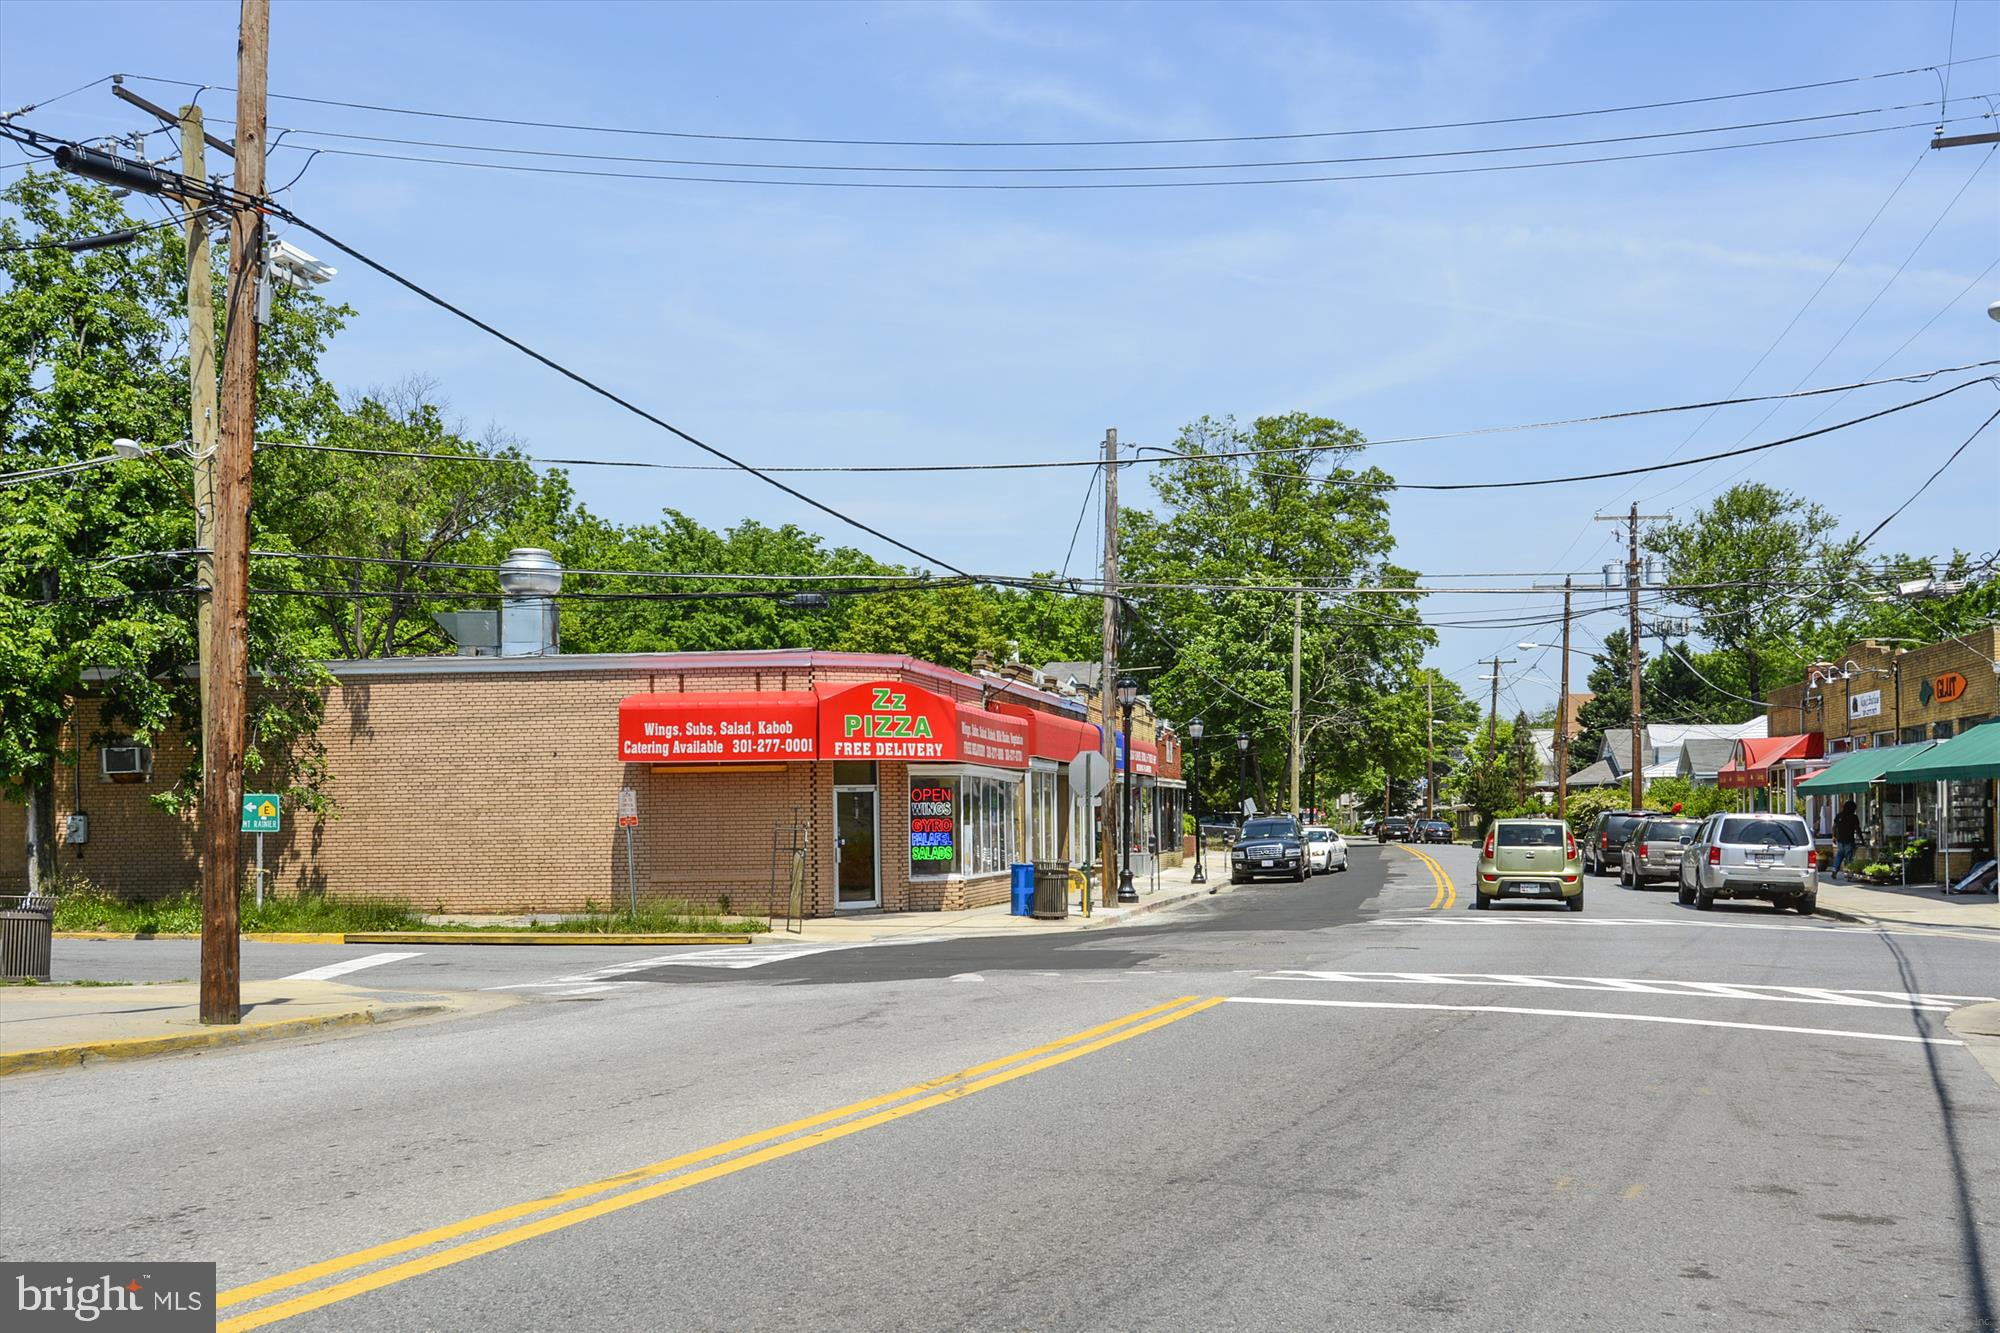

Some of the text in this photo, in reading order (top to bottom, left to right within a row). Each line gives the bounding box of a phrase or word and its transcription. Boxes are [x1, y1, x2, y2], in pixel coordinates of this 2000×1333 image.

[1936, 676, 1957, 699] GLUT
[872, 688, 906, 711] Zz
[758, 720, 793, 735] Kabob
[844, 714, 934, 738] PIZZA
[623, 738, 813, 757] Catering Available 301-277-0001
[834, 741, 943, 757] FREE DELIVERY
[911, 788, 952, 802] OPEN
[264, 805, 270, 814] E
[911, 802, 952, 816] WINGS
[911, 818, 953, 833] GYRO
[911, 832, 953, 846] FALAFEL
[911, 846, 953, 861] SALADS
